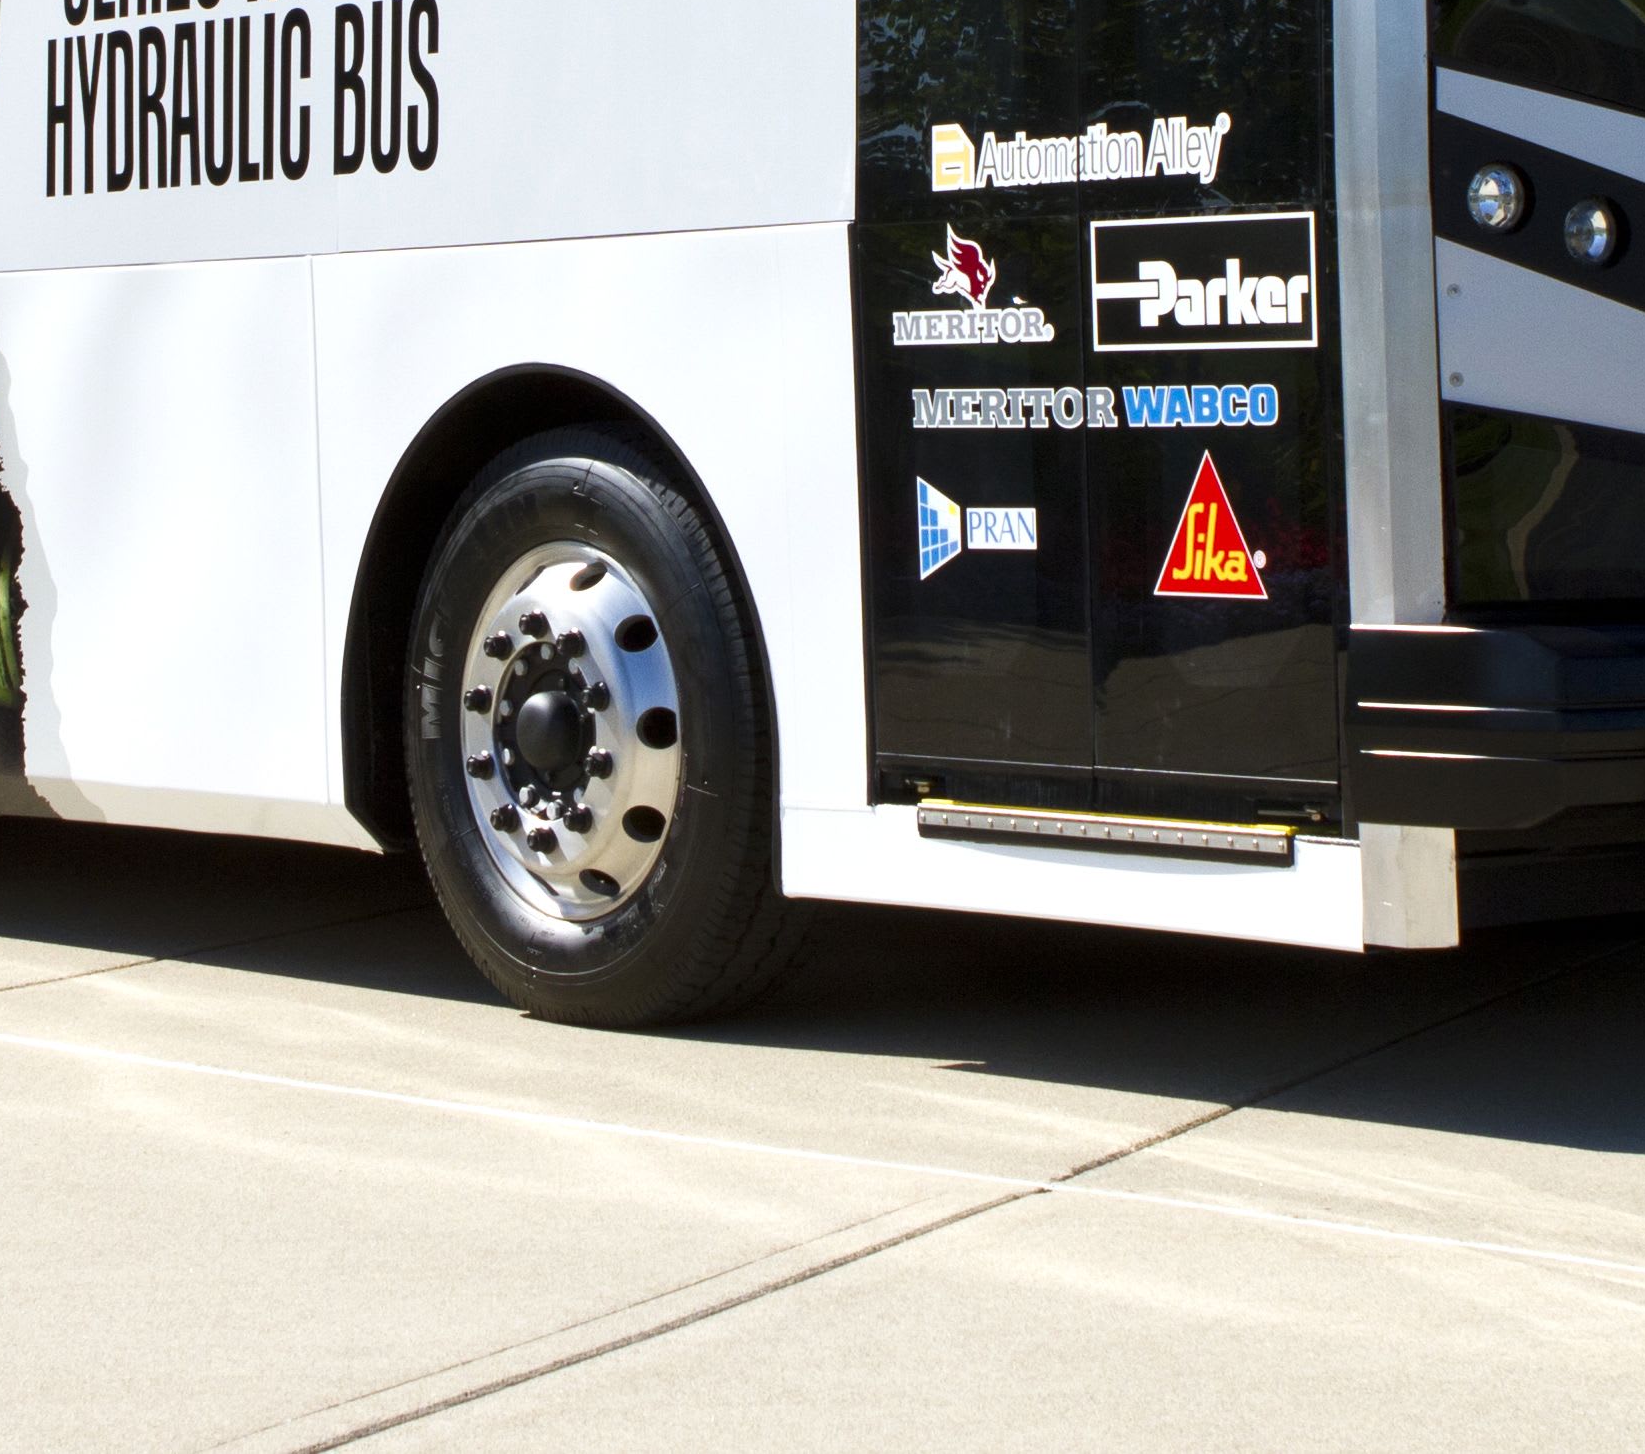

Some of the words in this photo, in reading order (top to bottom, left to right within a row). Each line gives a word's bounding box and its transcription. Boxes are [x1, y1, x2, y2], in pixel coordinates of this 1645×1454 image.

[45, 7, 312, 198] HYDRAULIC
[977, 126, 1142, 187] Automation
[1145, 119, 1221, 184] Alley
[1138, 258, 1309, 327] Parker
[895, 311, 1045, 343] MERITOR
[912, 387, 1118, 429] MERITOR
[1122, 384, 1278, 427] WABCO
[969, 510, 1036, 544] PRAN
[1171, 501, 1248, 583] Sika
